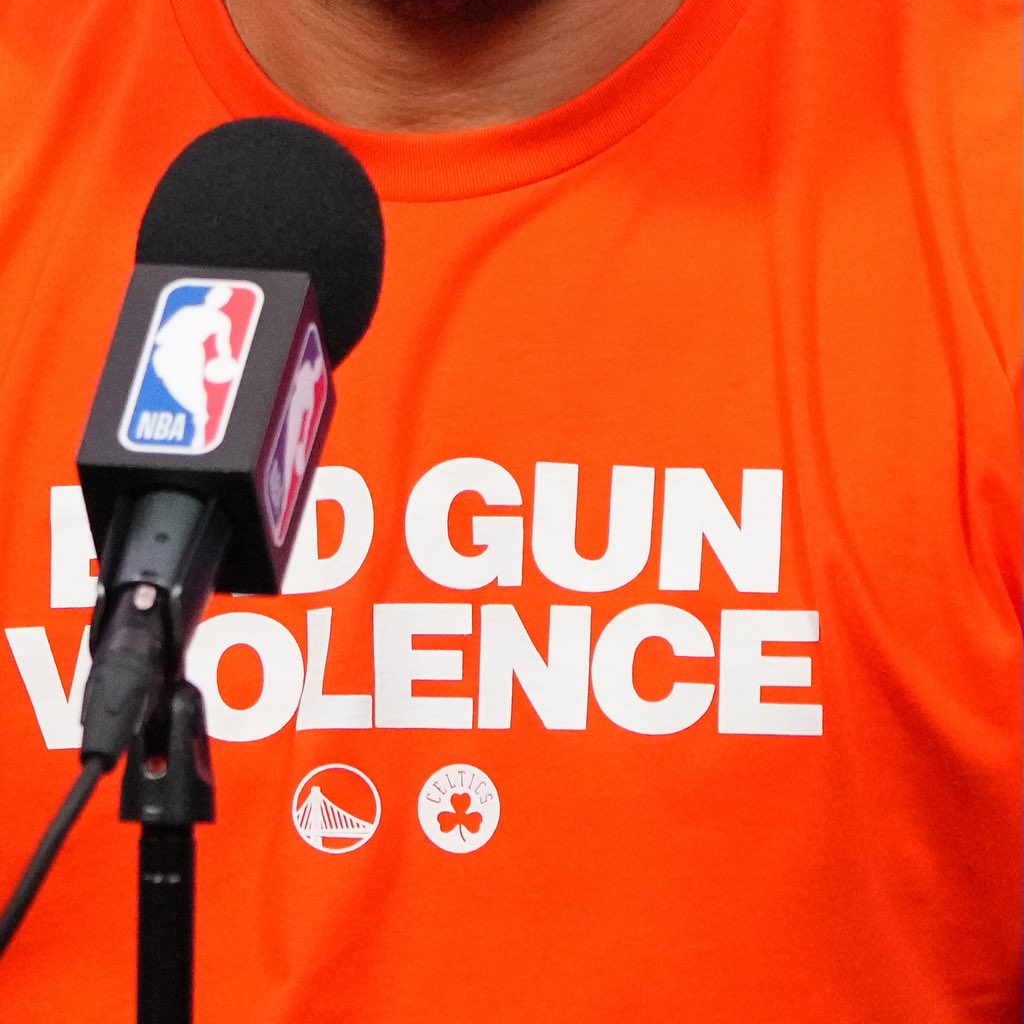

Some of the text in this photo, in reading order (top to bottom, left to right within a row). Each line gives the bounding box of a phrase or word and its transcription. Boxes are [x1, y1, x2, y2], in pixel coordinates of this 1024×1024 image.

[135, 410, 188, 441] NBA
[51, 465, 374, 608] ED
[405, 457, 783, 594] GUN
[5, 603, 824, 750] VOLENCE
[425, 770, 494, 805] CELTICS
